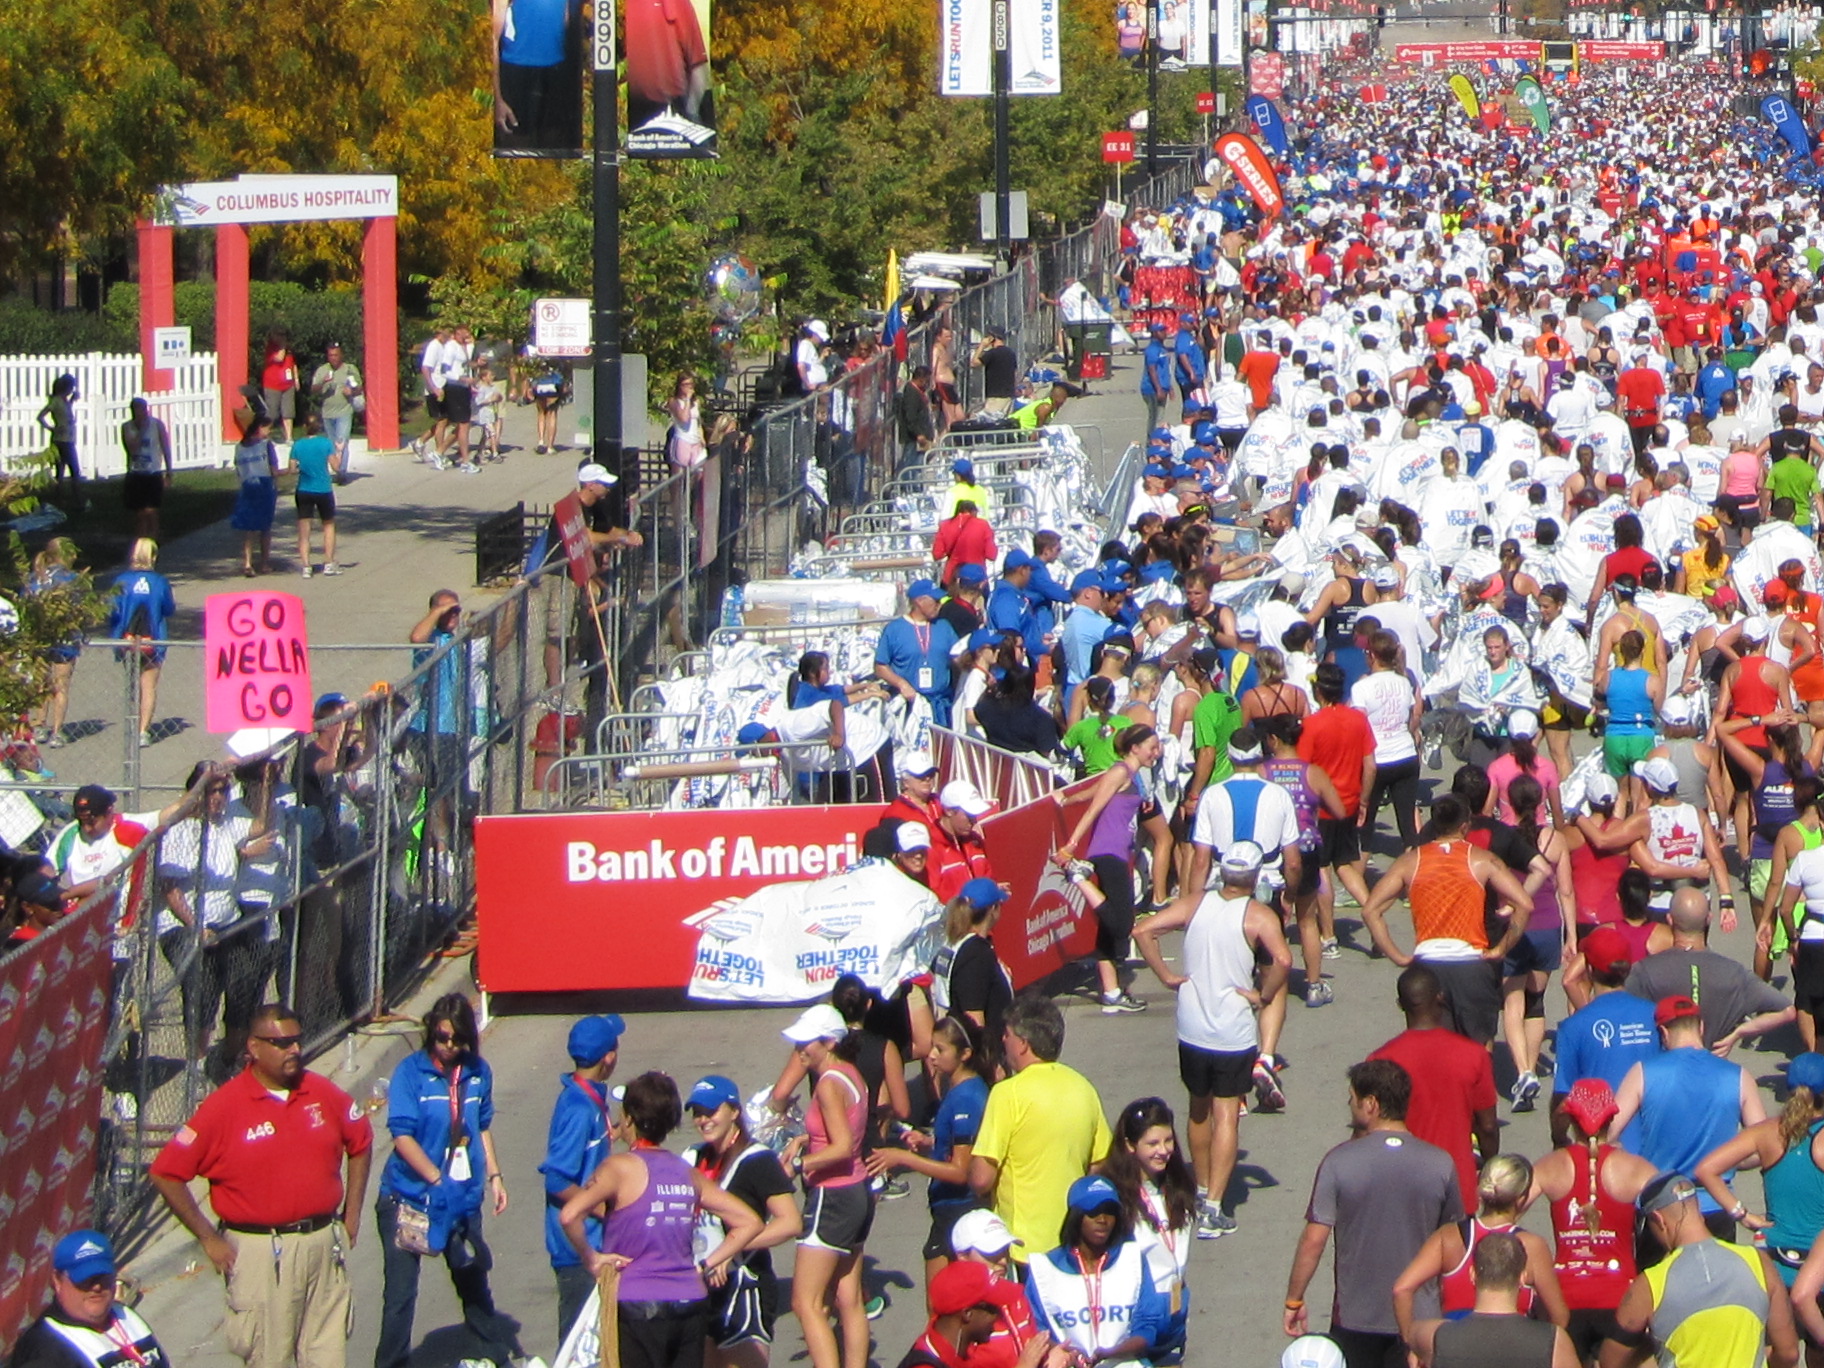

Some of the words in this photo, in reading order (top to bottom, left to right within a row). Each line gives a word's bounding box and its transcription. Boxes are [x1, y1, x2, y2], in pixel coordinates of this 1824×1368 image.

[1239, 156, 1280, 206] SERIES
[216, 194, 299, 212] COLUMBUS
[304, 188, 392, 208] HOSPITALITY
[227, 598, 287, 637] GO
[216, 637, 308, 679] NELLA
[241, 681, 294, 722] GO
[567, 836, 675, 883] Bank
[681, 835, 725, 879] of
[731, 831, 857, 877] Ameri
[697, 947, 764, 974] TOGETH
[796, 944, 880, 970] TOGETHER
[694, 962, 765, 989] LET'SRU
[246, 1120, 276, 1141] 446
